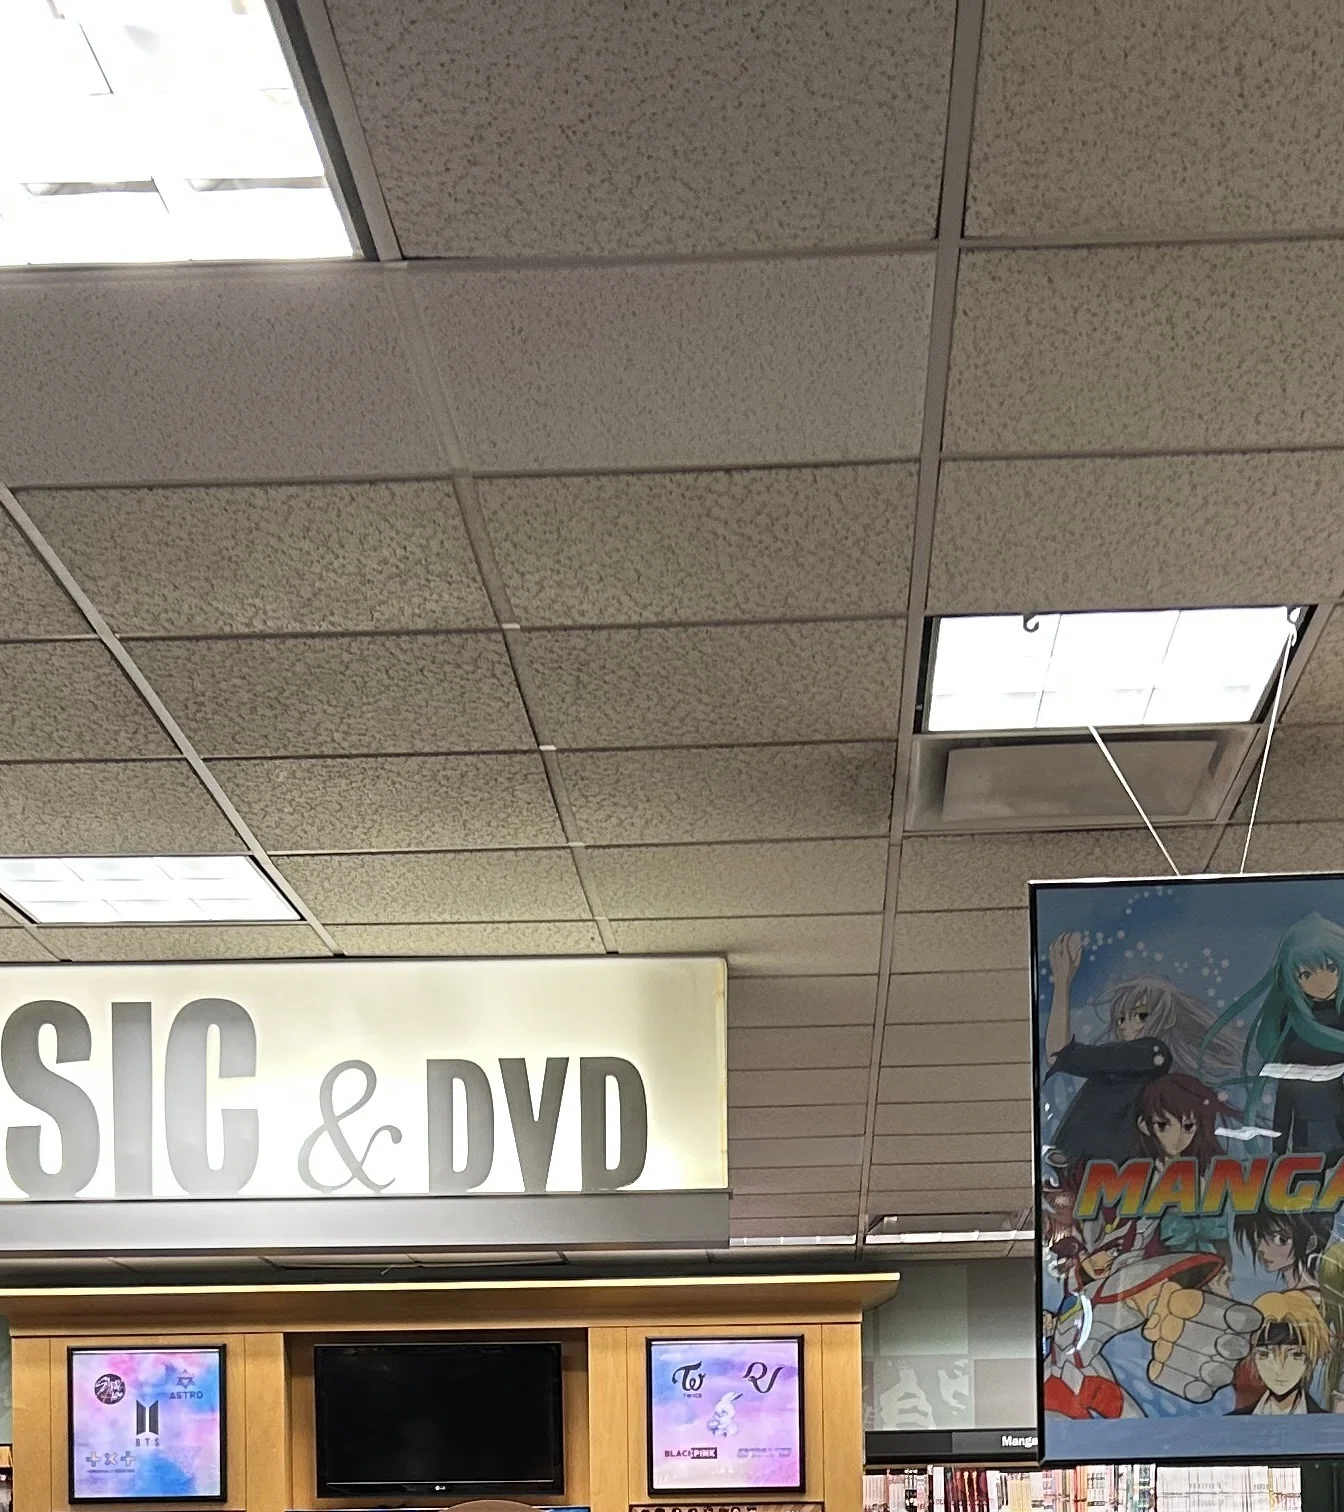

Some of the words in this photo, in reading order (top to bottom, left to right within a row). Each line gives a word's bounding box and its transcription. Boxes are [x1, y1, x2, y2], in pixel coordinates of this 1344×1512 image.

[296, 1059, 402, 1194] &
[425, 1056, 648, 1193] DVD
[168, 1391, 204, 1400] ASTRO
[135, 1437, 160, 1447] BTS
[1001, 1435, 1039, 1449] Manga
